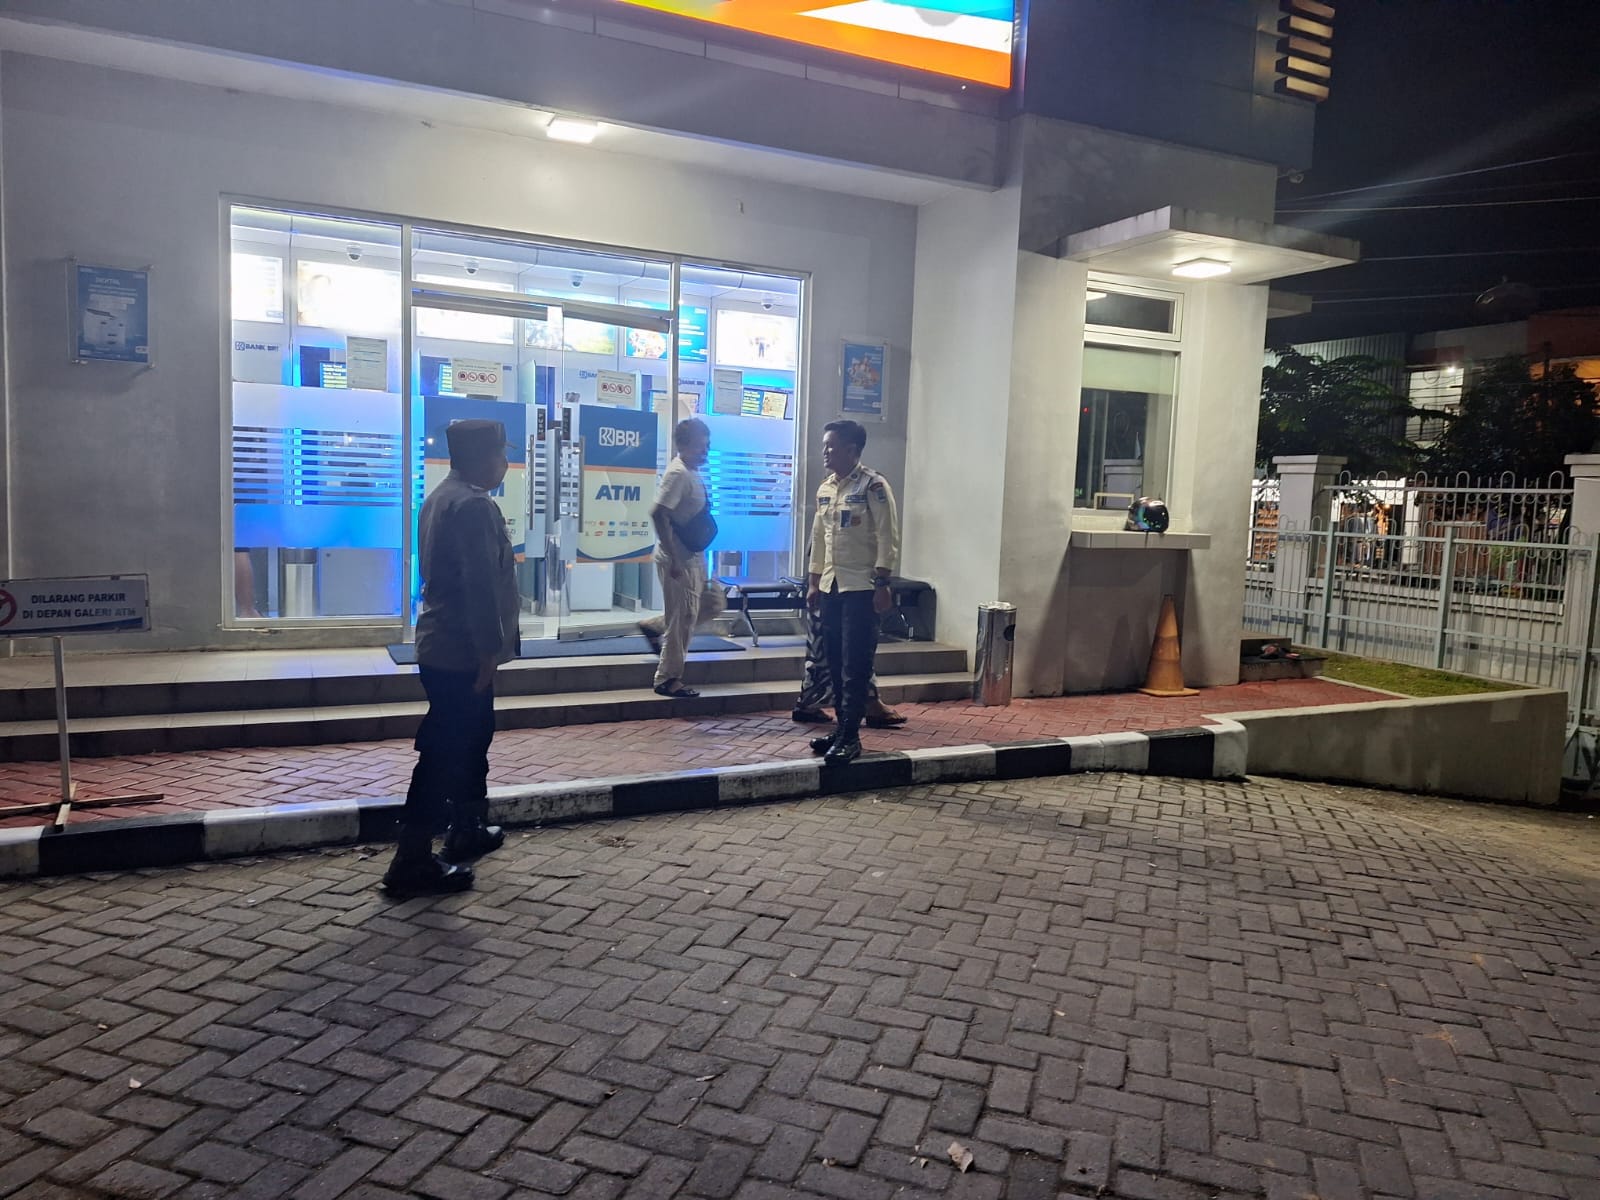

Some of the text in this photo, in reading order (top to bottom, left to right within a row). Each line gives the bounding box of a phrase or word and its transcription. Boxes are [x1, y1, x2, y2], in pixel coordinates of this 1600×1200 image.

[615, 429, 640, 447] BRI
[595, 484, 640, 501] ATM
[31, 592, 126, 604] DILARANG PARKIR
[22, 610, 33, 619] DI
[36, 608, 71, 618] DEPAN
[74, 607, 112, 617] GALERI
